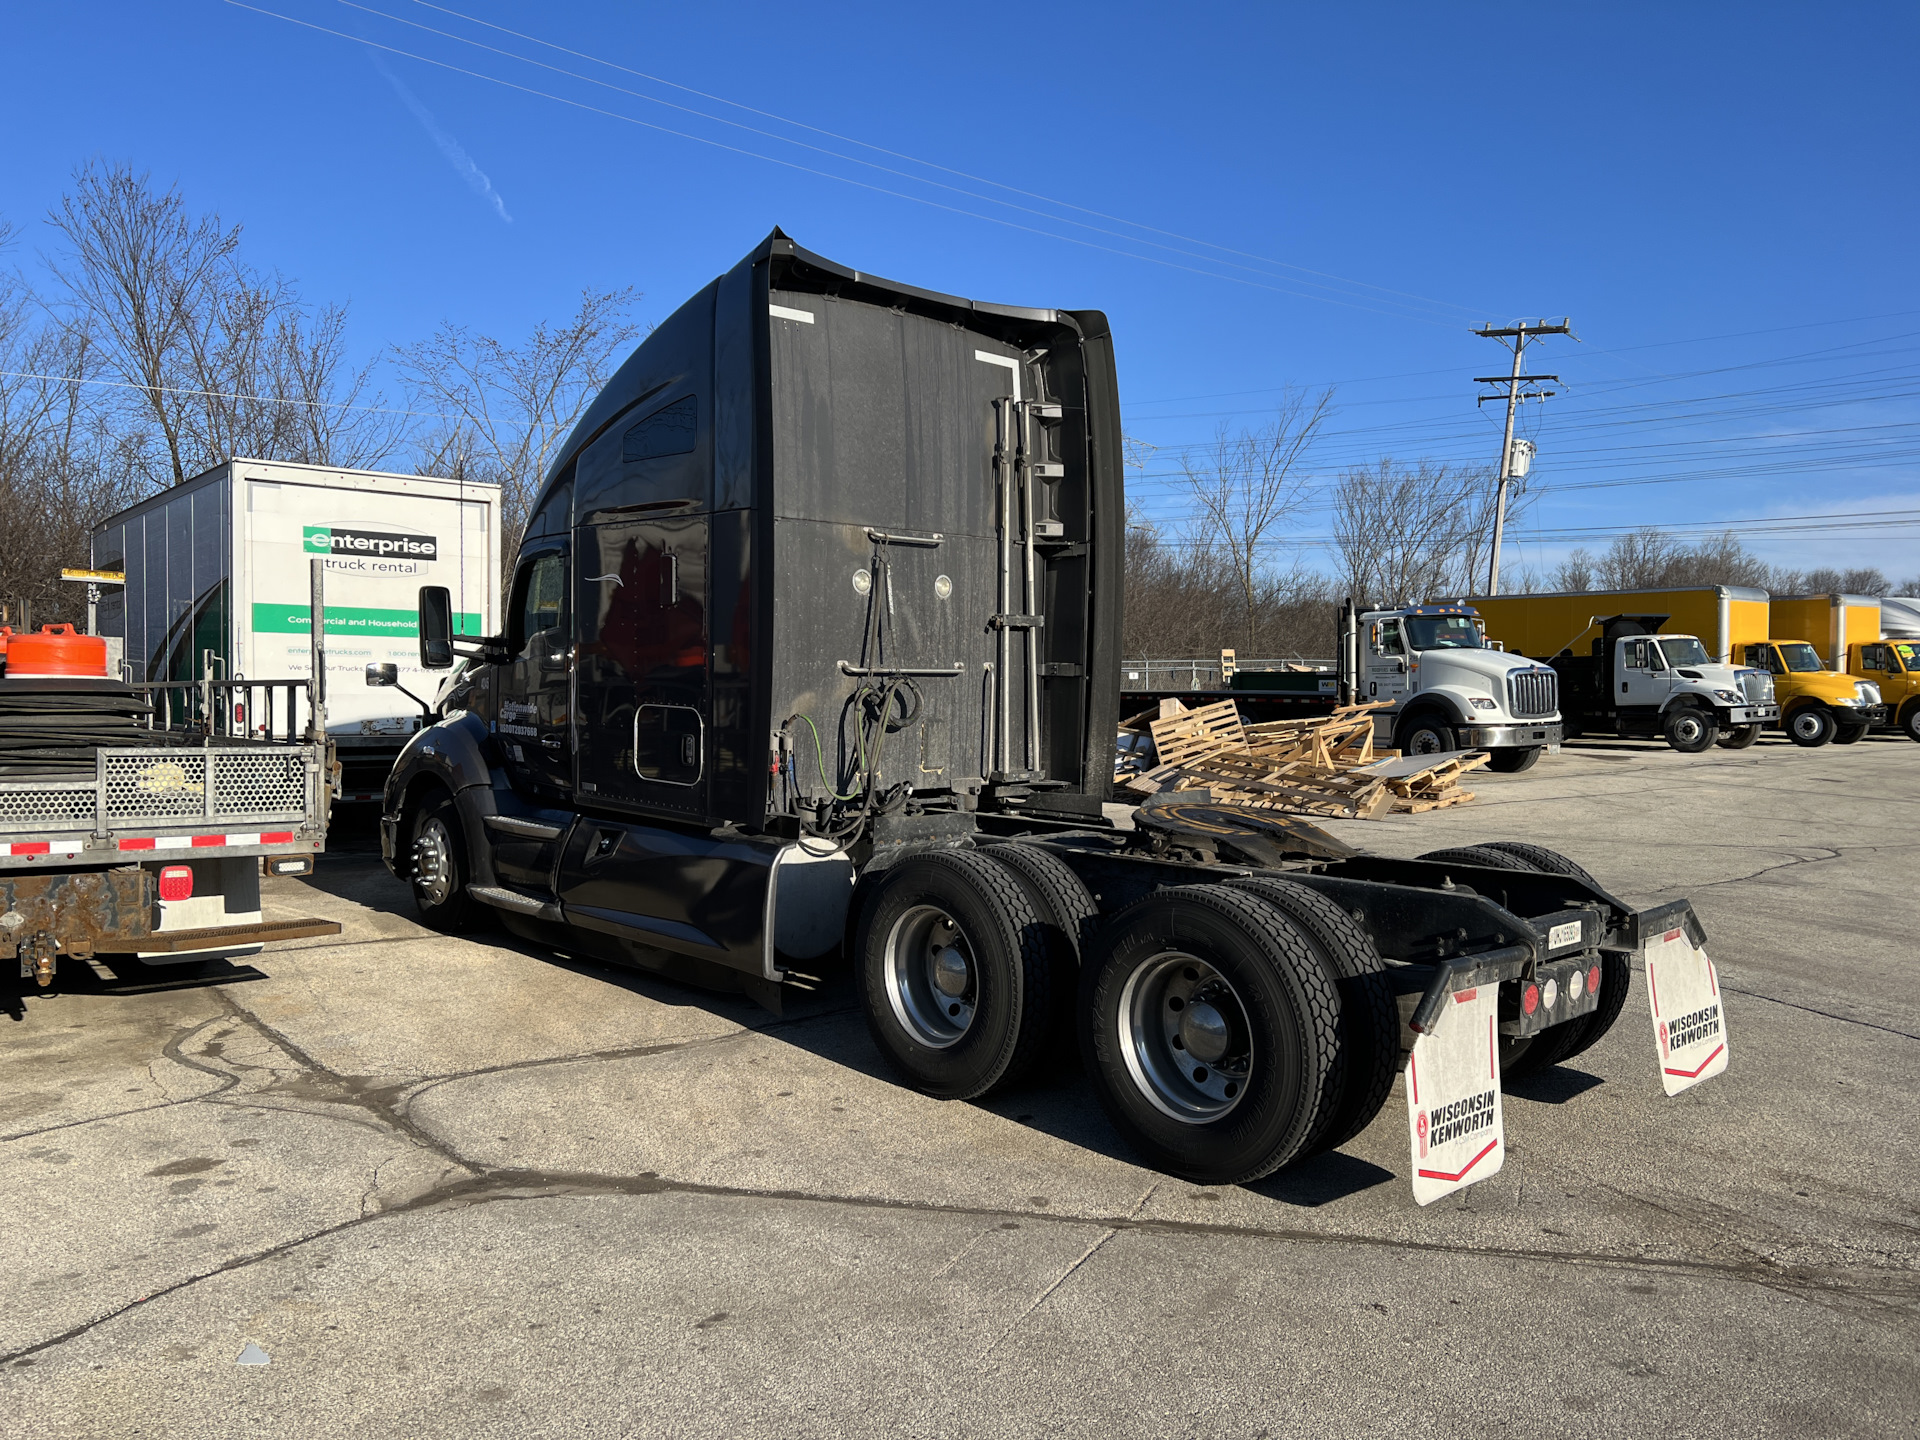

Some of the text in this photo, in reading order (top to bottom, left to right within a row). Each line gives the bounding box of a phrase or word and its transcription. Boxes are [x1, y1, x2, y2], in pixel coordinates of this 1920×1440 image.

[309, 533, 436, 555] enterprise
[325, 558, 417, 574] truck rental
[287, 615, 418, 629] Comrcial and Household
[500, 708, 516, 722] Cargo
[1669, 1004, 1718, 1036] WISCONSIN
[1670, 1019, 1719, 1051] KENWORTH
[1430, 1089, 1495, 1128] WISCONSIN
[1430, 1108, 1494, 1148] KENWORTH
[1470, 1128, 1493, 1141] Company
